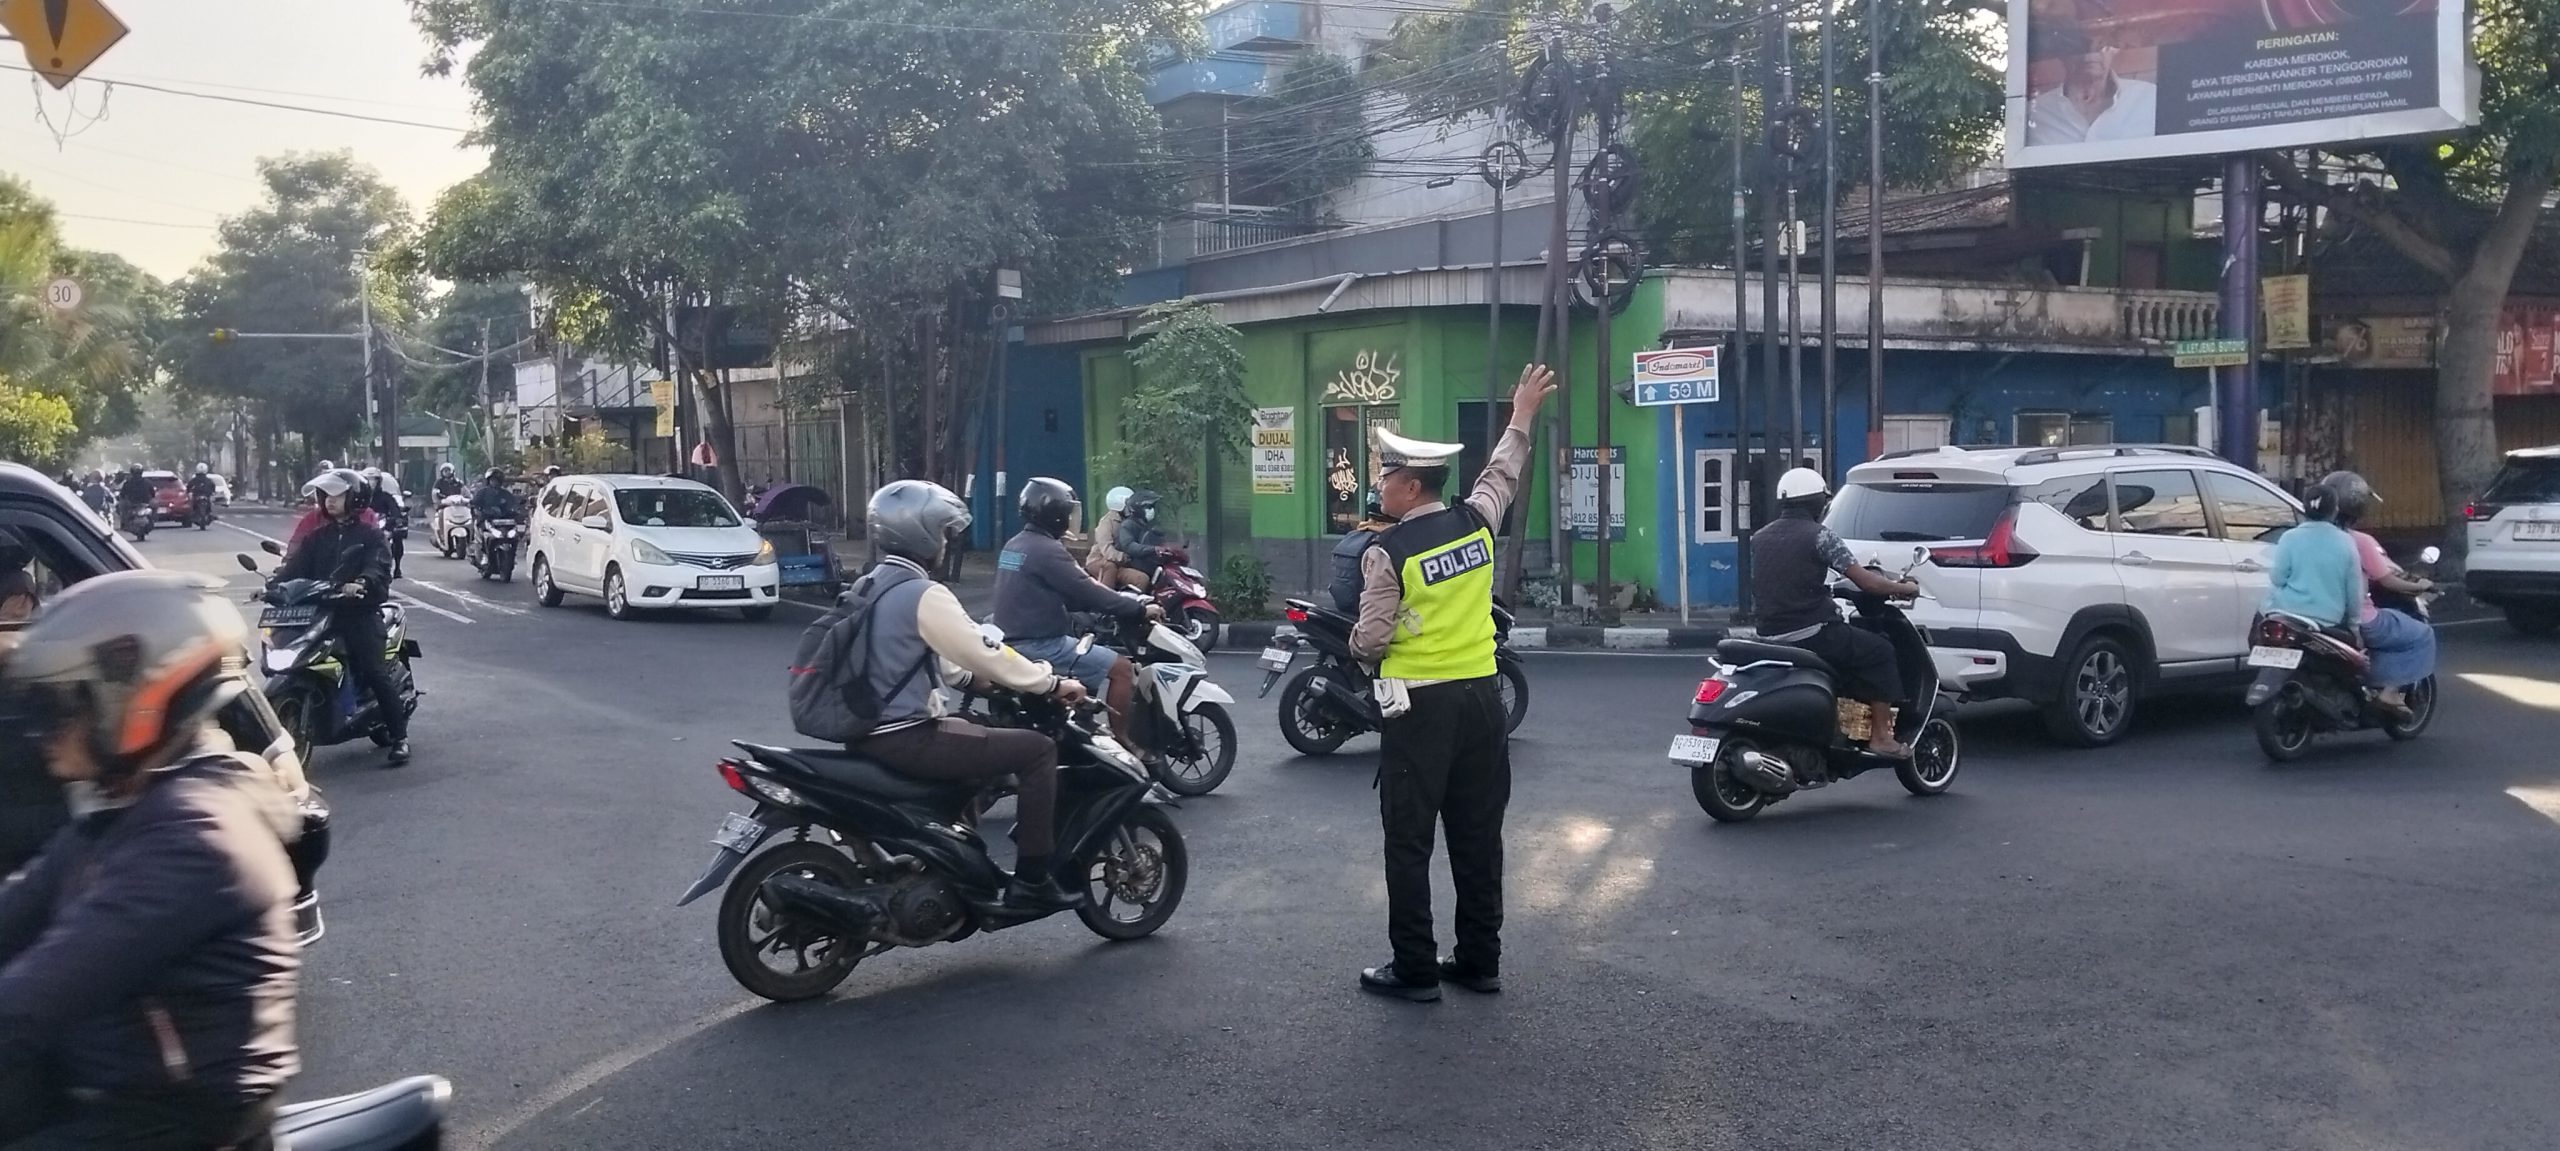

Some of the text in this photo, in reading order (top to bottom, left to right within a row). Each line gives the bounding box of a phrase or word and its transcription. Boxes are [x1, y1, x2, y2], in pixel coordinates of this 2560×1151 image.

[2256, 32, 2339, 49] PERINGATAN:
[2244, 57, 2289, 69] KARENA
[2191, 56, 2408, 88] SAYA TERKENA KANKER TENGGOROKAN
[2187, 89, 2230, 101] LAYANAN
[2232, 83, 2280, 96] BERHENTI
[2282, 79, 2333, 91] MEROKOK
[2188, 117, 2218, 126] ORANG
[2230, 113, 2260, 122] BAWAH
[2274, 109, 2302, 118] TAHUN
[2303, 106, 2322, 115] DAN
[2323, 101, 2379, 113] PEREMPUAN
[2381, 98, 2408, 107] HAMIL
[2207, 91, 2389, 116] DILARANG MENJUAL DAN MEMBERI KEPADA
[53, 285, 71, 302] 30
[1651, 359, 1702, 372] Indomaret
[1669, 381, 1712, 399] 50 M
[1264, 449, 1286, 461] IDHA
[1571, 467, 1620, 480] DIJUL
[1424, 541, 1488, 581] POLISI
